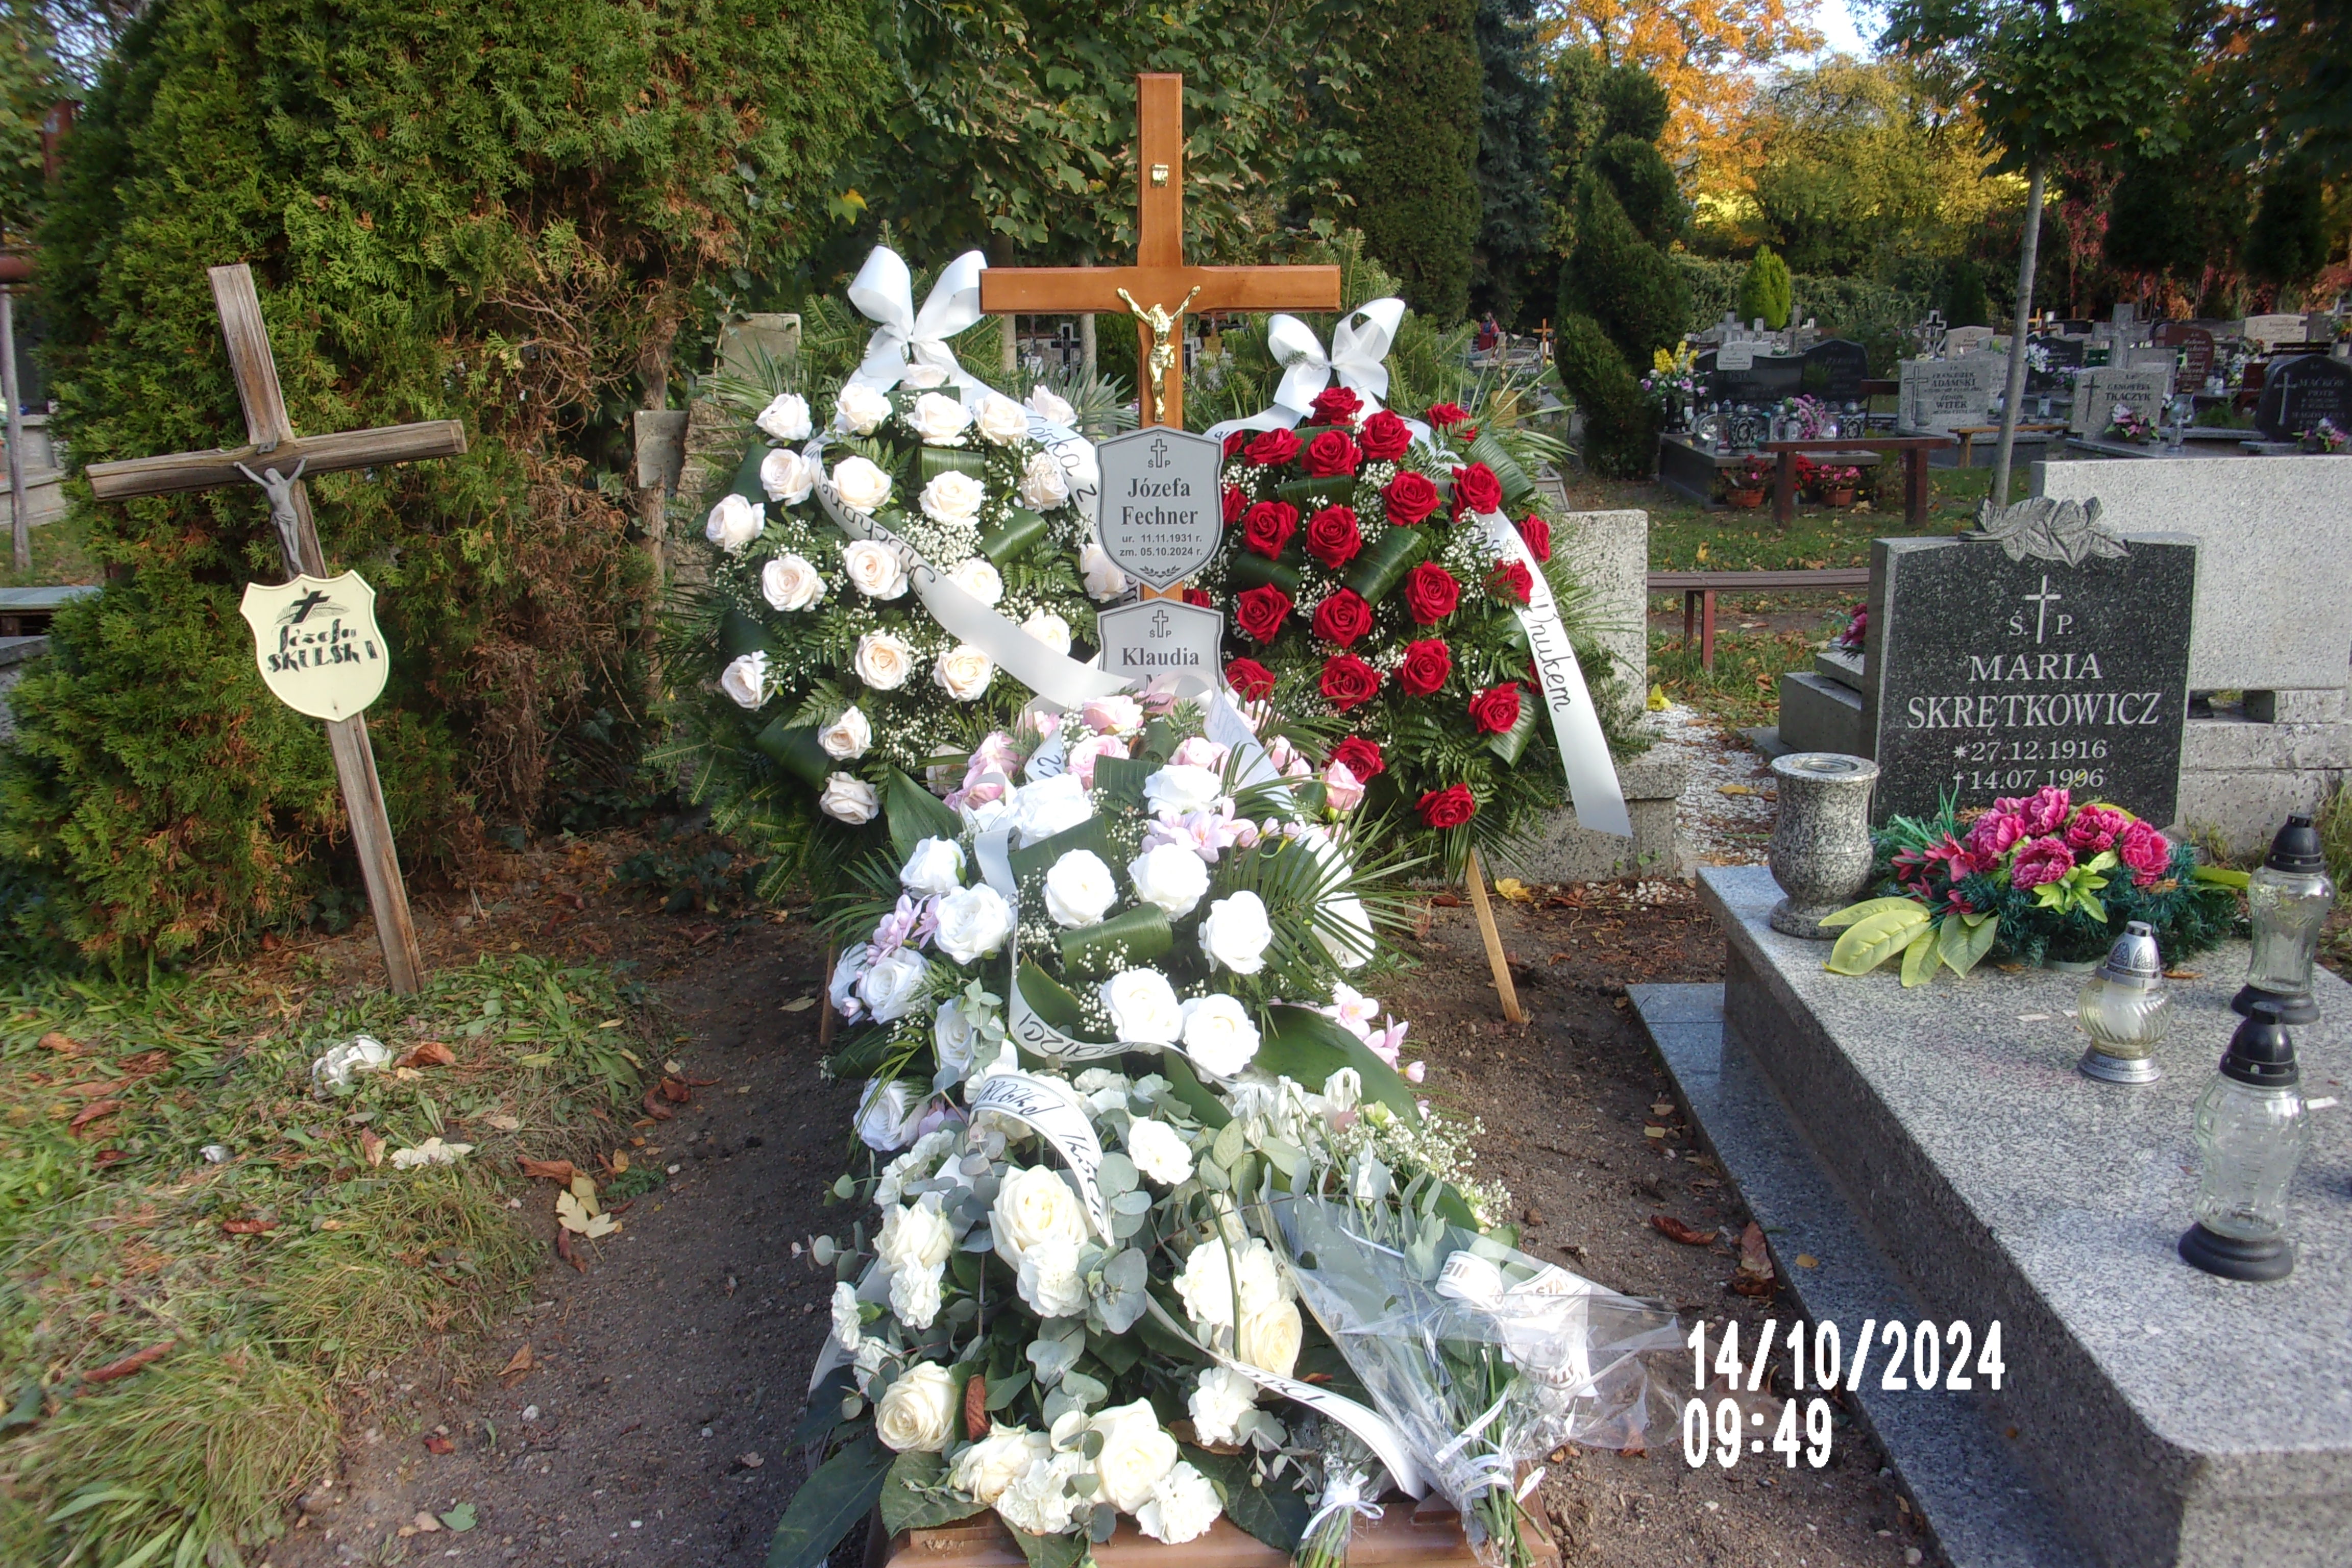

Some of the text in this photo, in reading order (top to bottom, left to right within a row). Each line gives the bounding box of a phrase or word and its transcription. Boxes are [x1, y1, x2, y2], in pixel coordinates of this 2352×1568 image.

[1932, 379, 1975, 387] ADAMSKI
[2105, 392, 2151, 401] TKACZYK
[1127, 477, 1191, 498] Józefa
[1121, 505, 1198, 525] Fechner
[1121, 534, 1135, 543] ur.
[1141, 533, 1192, 543] 11.11.1931
[1119, 549, 1138, 557] zm.
[1140, 547, 1193, 557] 05.10.2024
[1121, 647, 1199, 667] Klaudia
[1968, 653, 2103, 682] MARIA
[1906, 692, 2163, 736] SKRĘTKOWICZ
